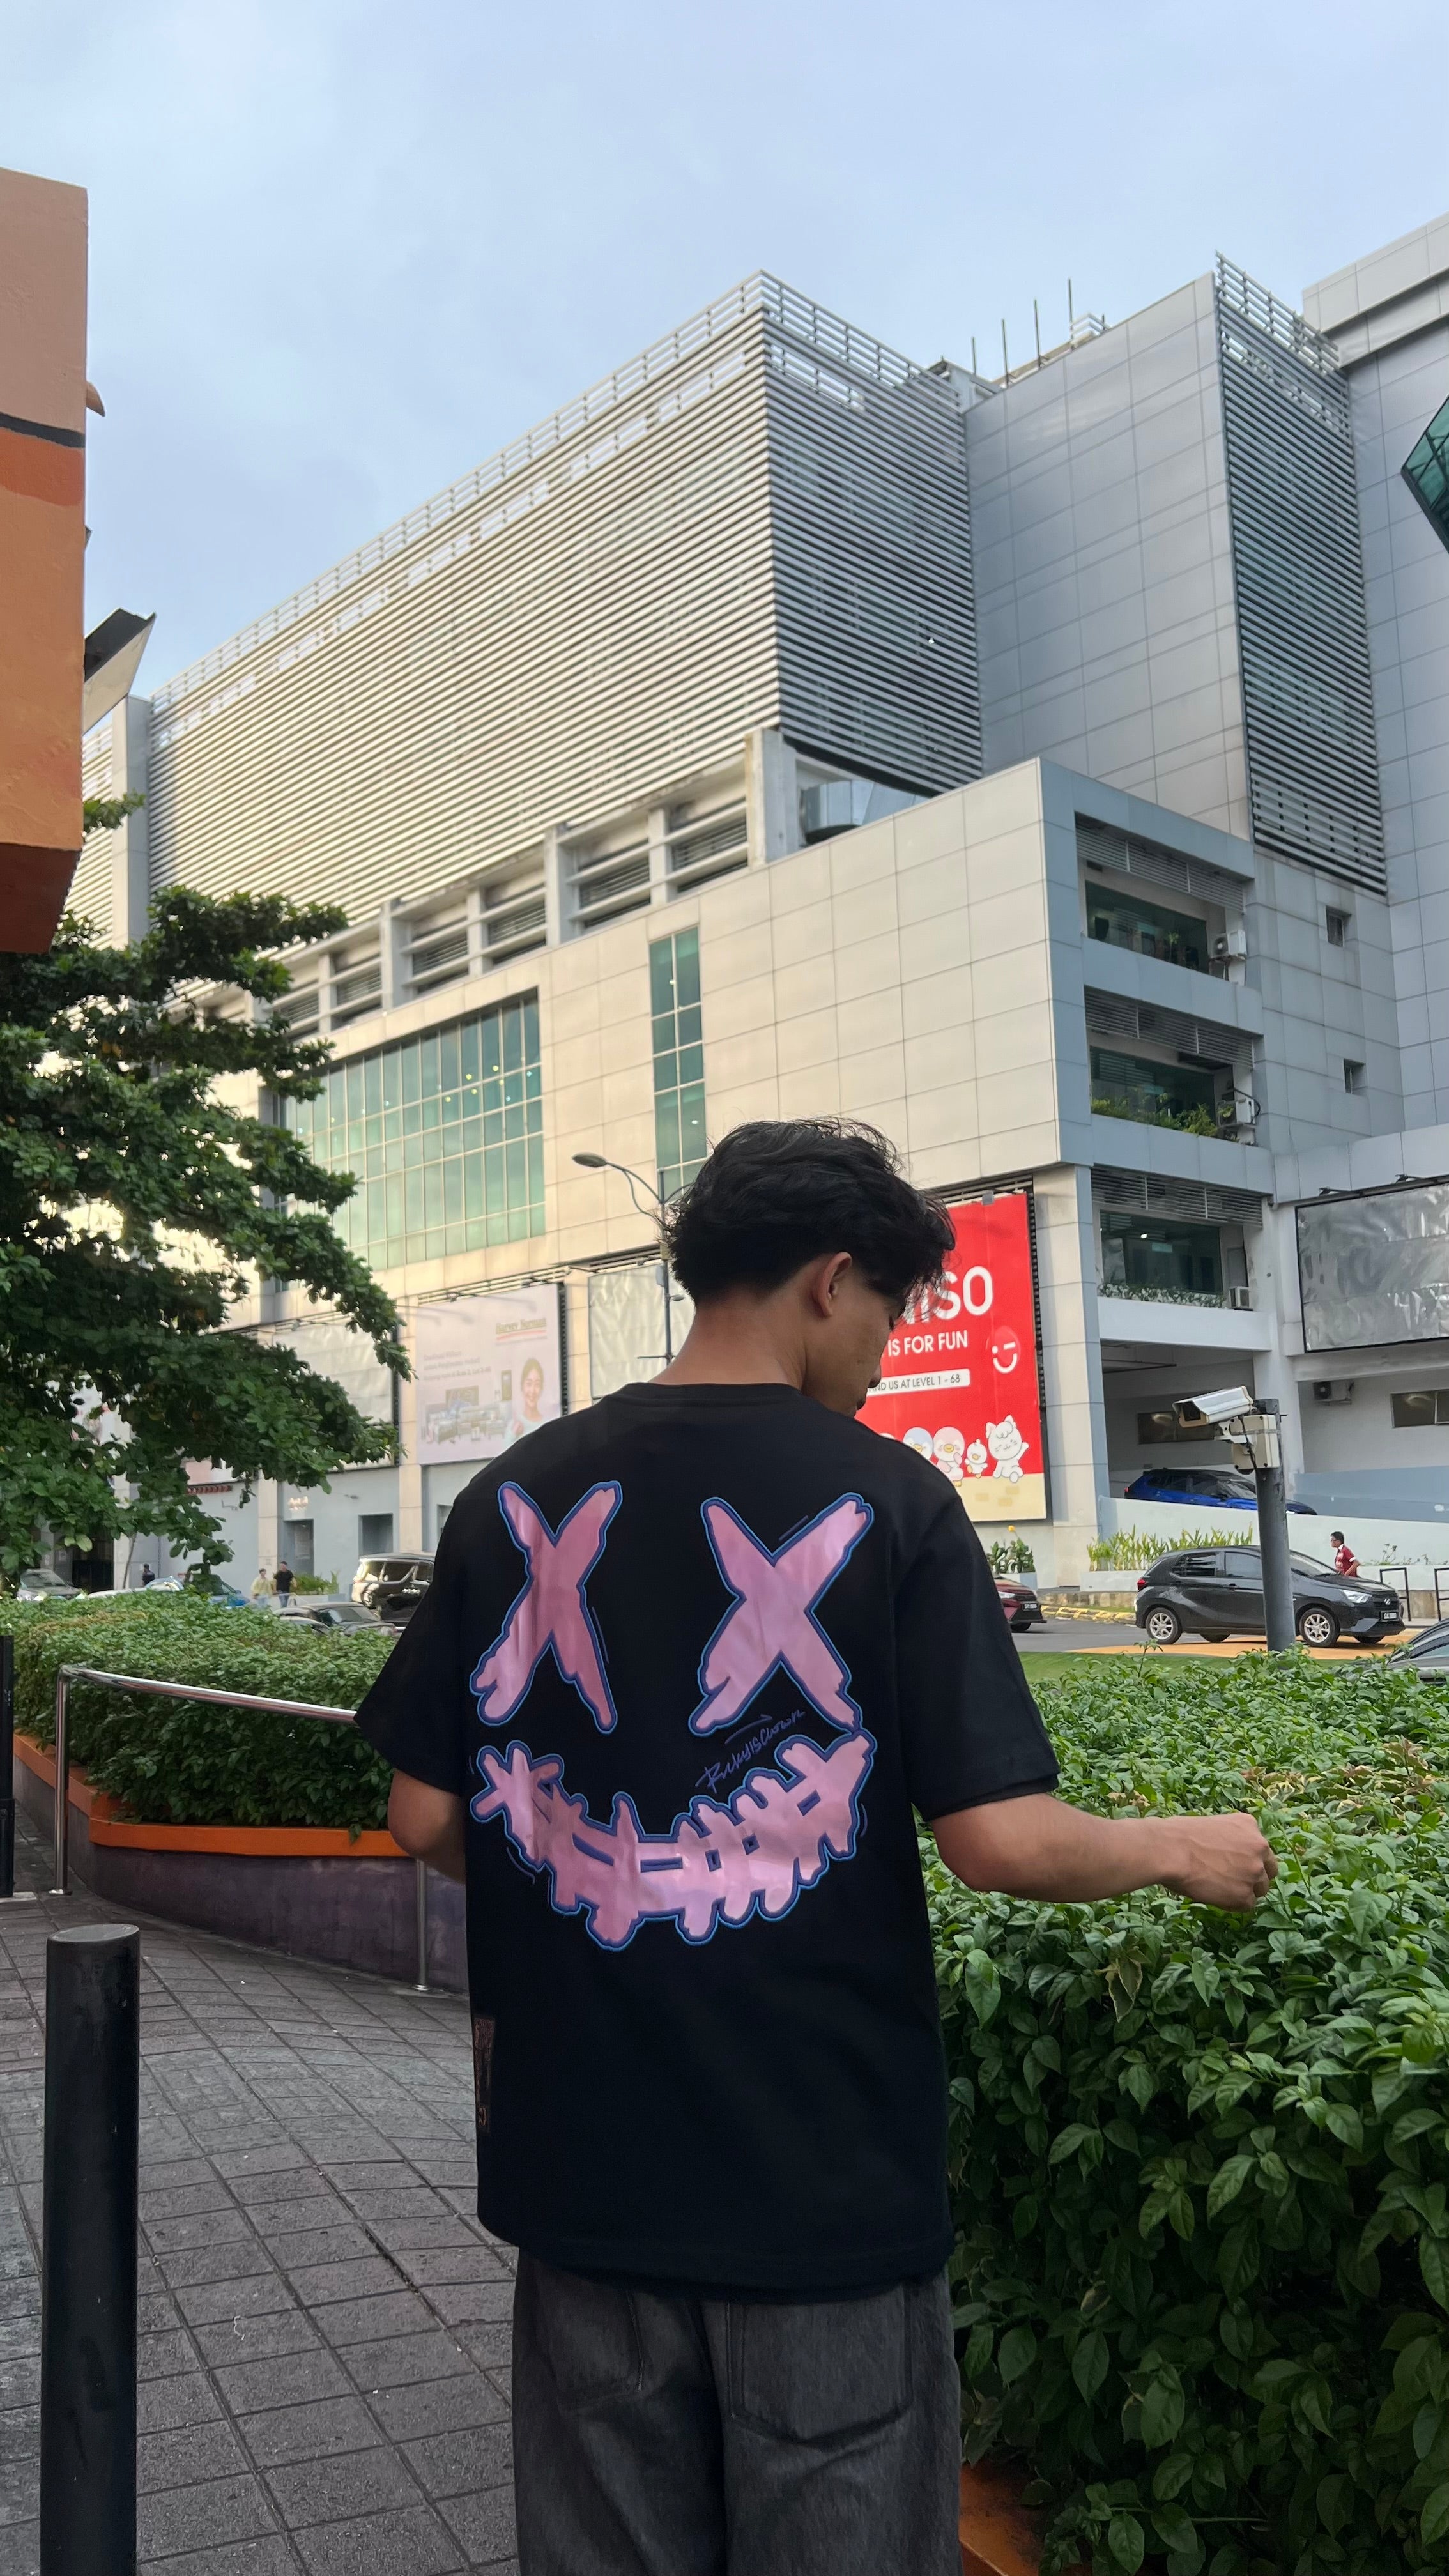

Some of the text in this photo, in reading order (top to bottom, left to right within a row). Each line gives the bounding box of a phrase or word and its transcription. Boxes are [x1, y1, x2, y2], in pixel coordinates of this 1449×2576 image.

[887, 1330, 968, 1357] IS FOR FUN
[889, 1380, 898, 1390] US
[901, 1379, 910, 1389] AT
[912, 1377, 935, 1387] LEVEL
[937, 1376, 941, 1385] 1
[950, 1374, 960, 1384] 68
